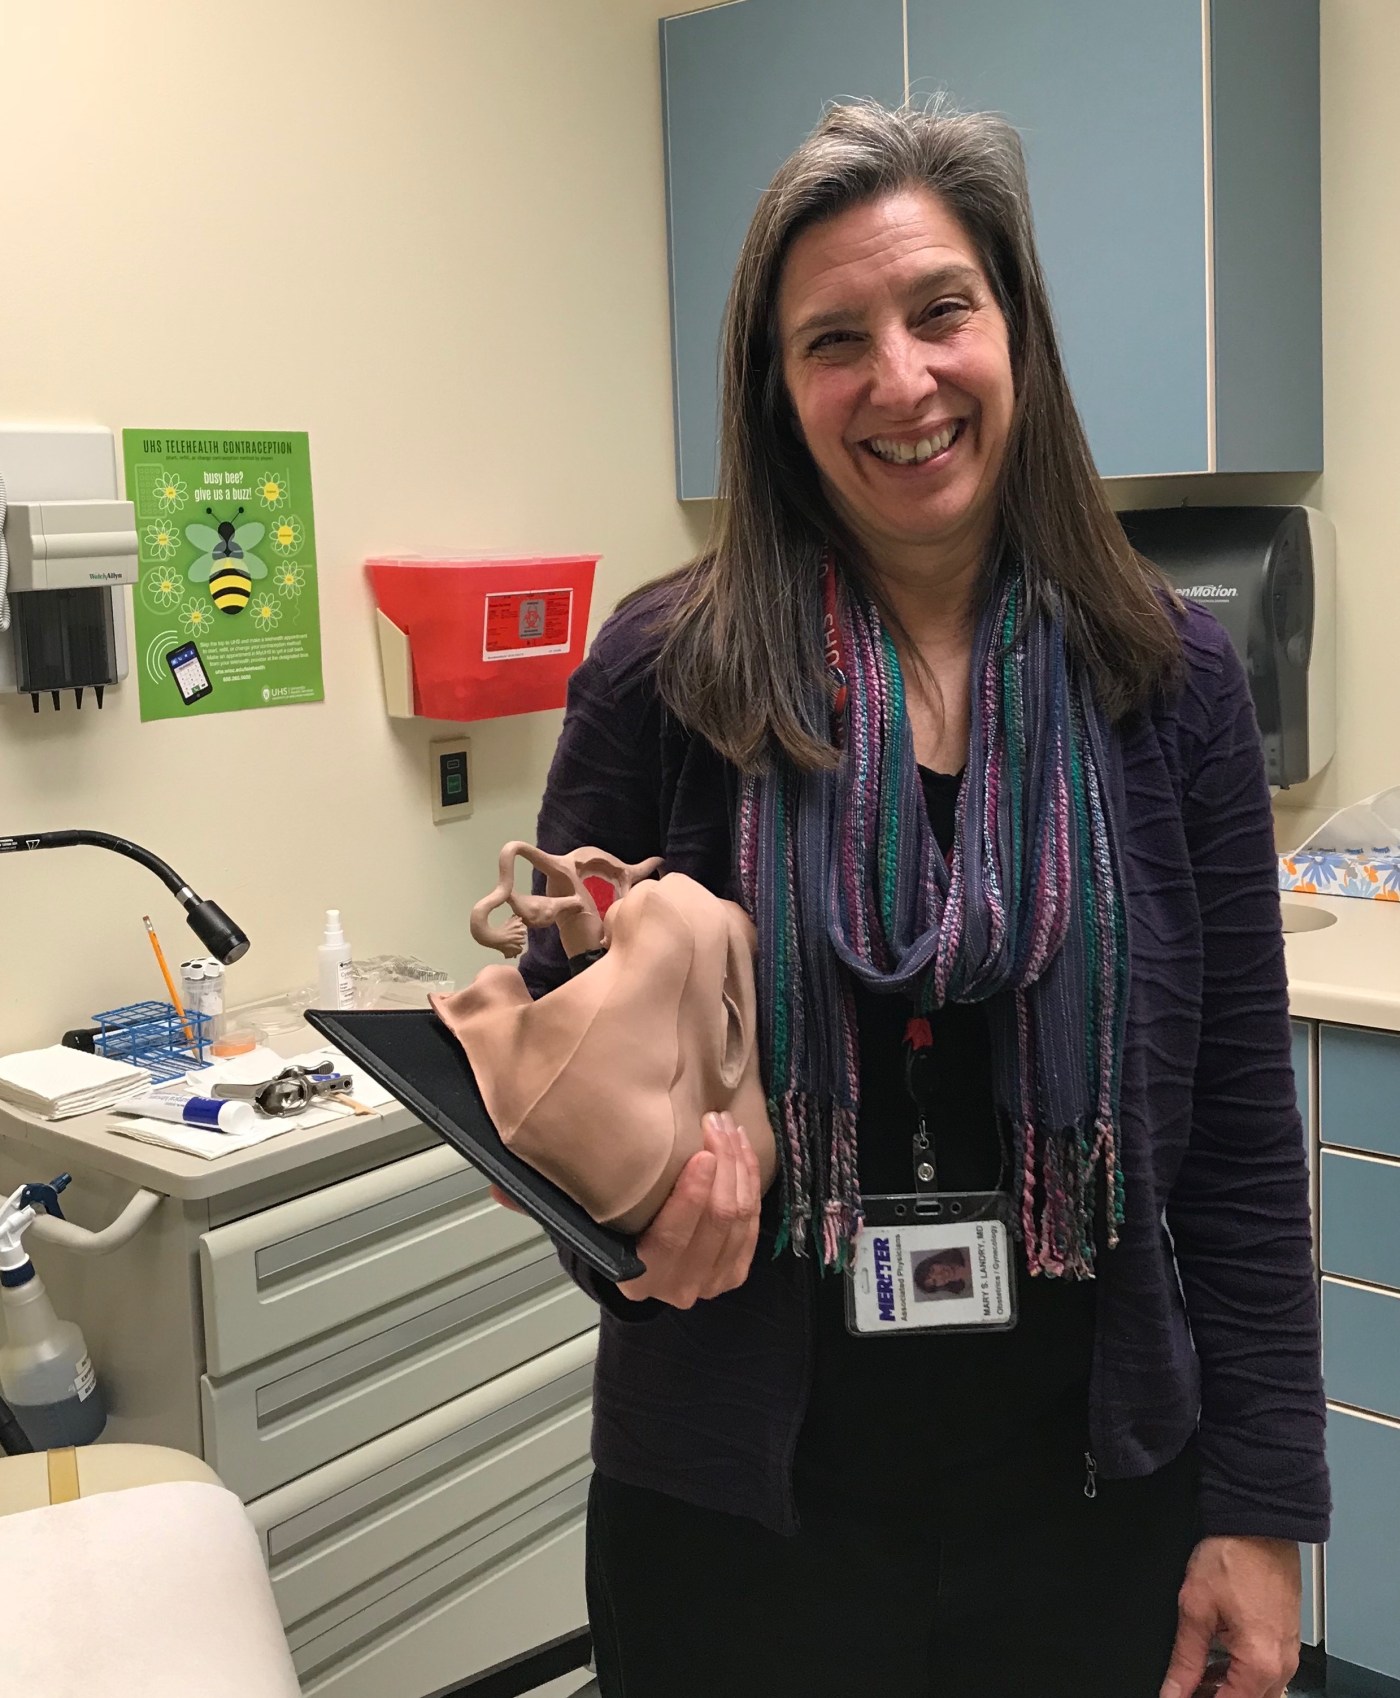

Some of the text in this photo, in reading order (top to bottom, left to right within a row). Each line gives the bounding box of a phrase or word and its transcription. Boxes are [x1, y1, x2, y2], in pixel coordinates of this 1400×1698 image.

[144, 440, 292, 454] UHS TELEHEALTH CONTRACEPTION
[195, 487, 252, 502] give us a buzz!
[203, 471, 244, 486] busy bee?
[272, 688, 287, 696] UHS
[990, 1225, 1000, 1270] Gynecology
[873, 1238, 896, 1322] MERITER
[895, 1234, 908, 1322] Associated Physicians
[976, 1225, 990, 1316] MARY S. LANDRY, MD
[994, 1276, 1004, 1316] Obstetrics
